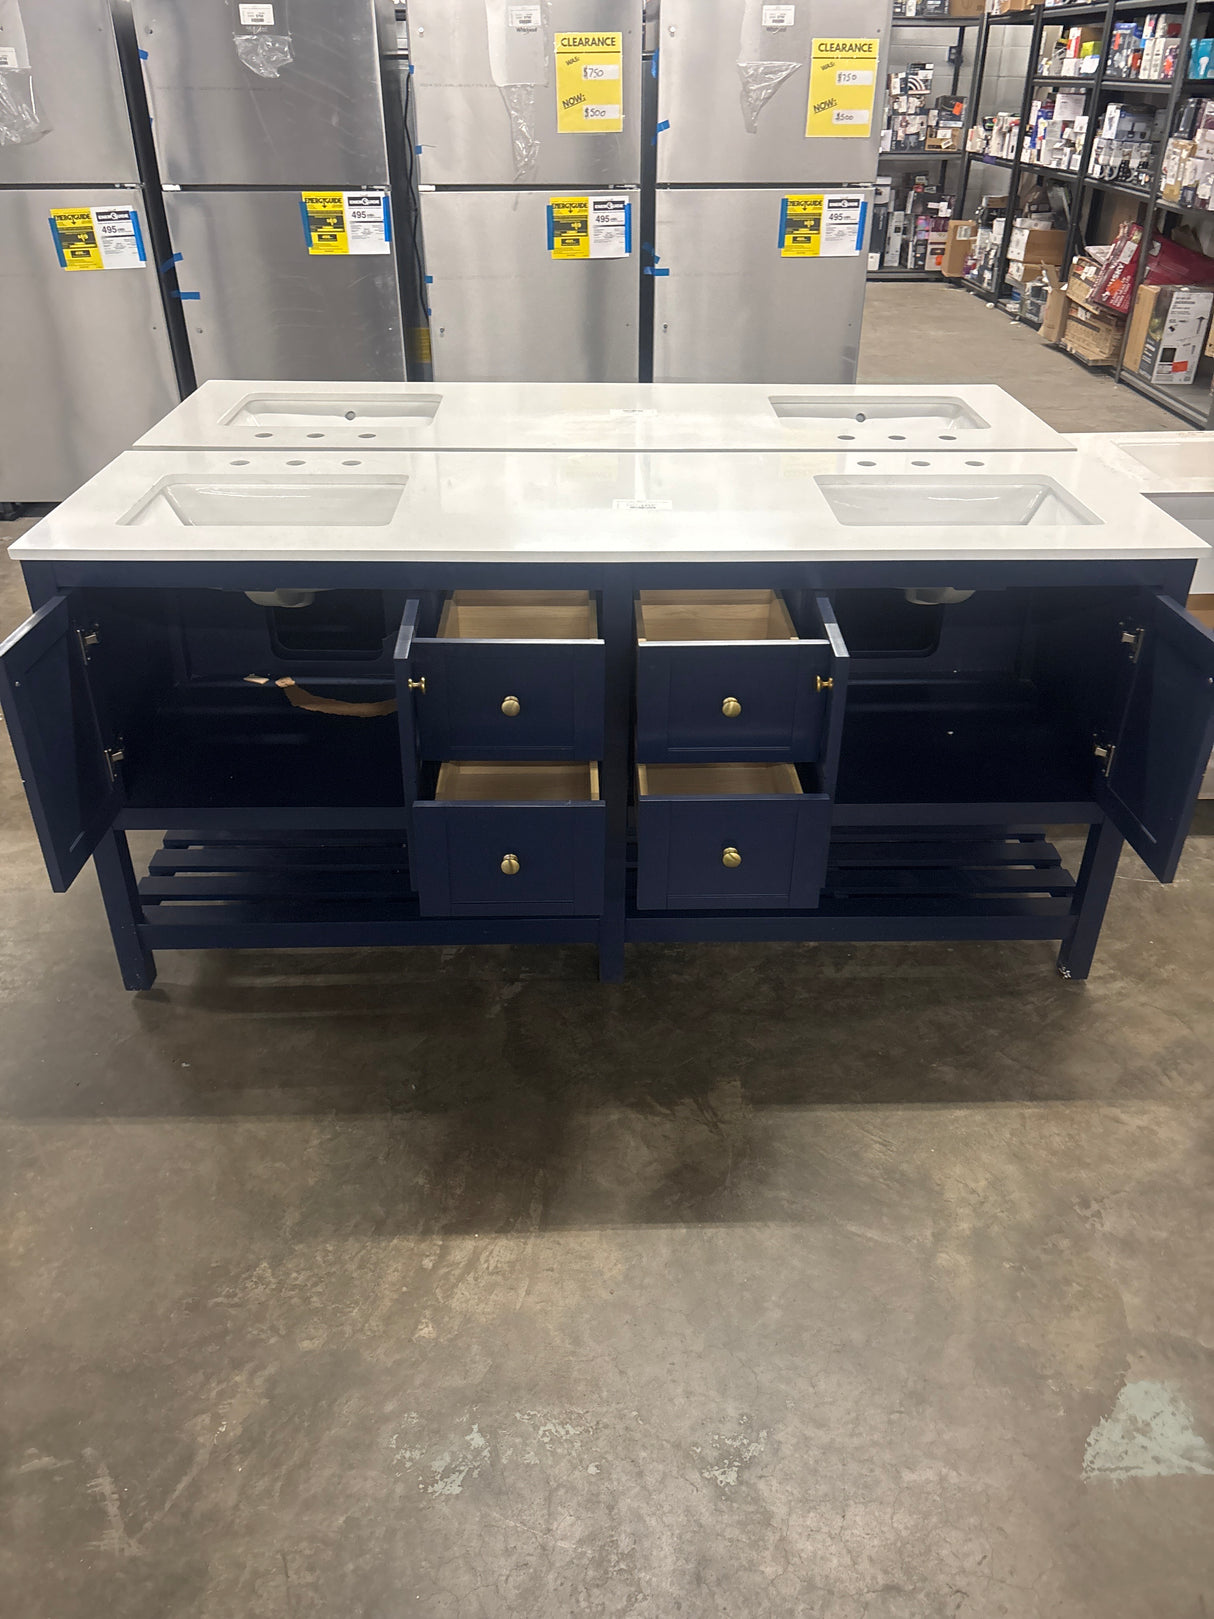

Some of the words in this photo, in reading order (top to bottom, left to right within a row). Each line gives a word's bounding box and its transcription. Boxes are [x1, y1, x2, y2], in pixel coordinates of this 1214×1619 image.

[560, 37, 617, 47] CLEARANCE
[818, 43, 873, 52] CLEARANCE
[583, 66, 604, 79] $750
[837, 72, 857, 83] $750
[562, 93, 586, 109] NOW:
[813, 98, 837, 113] NOW:
[584, 107, 606, 119] $500
[834, 112, 854, 122] $500
[351, 210, 367, 219] 495
[595, 215, 610, 223] 495
[829, 213, 844, 221] 495
[101, 225, 118, 234] 495
